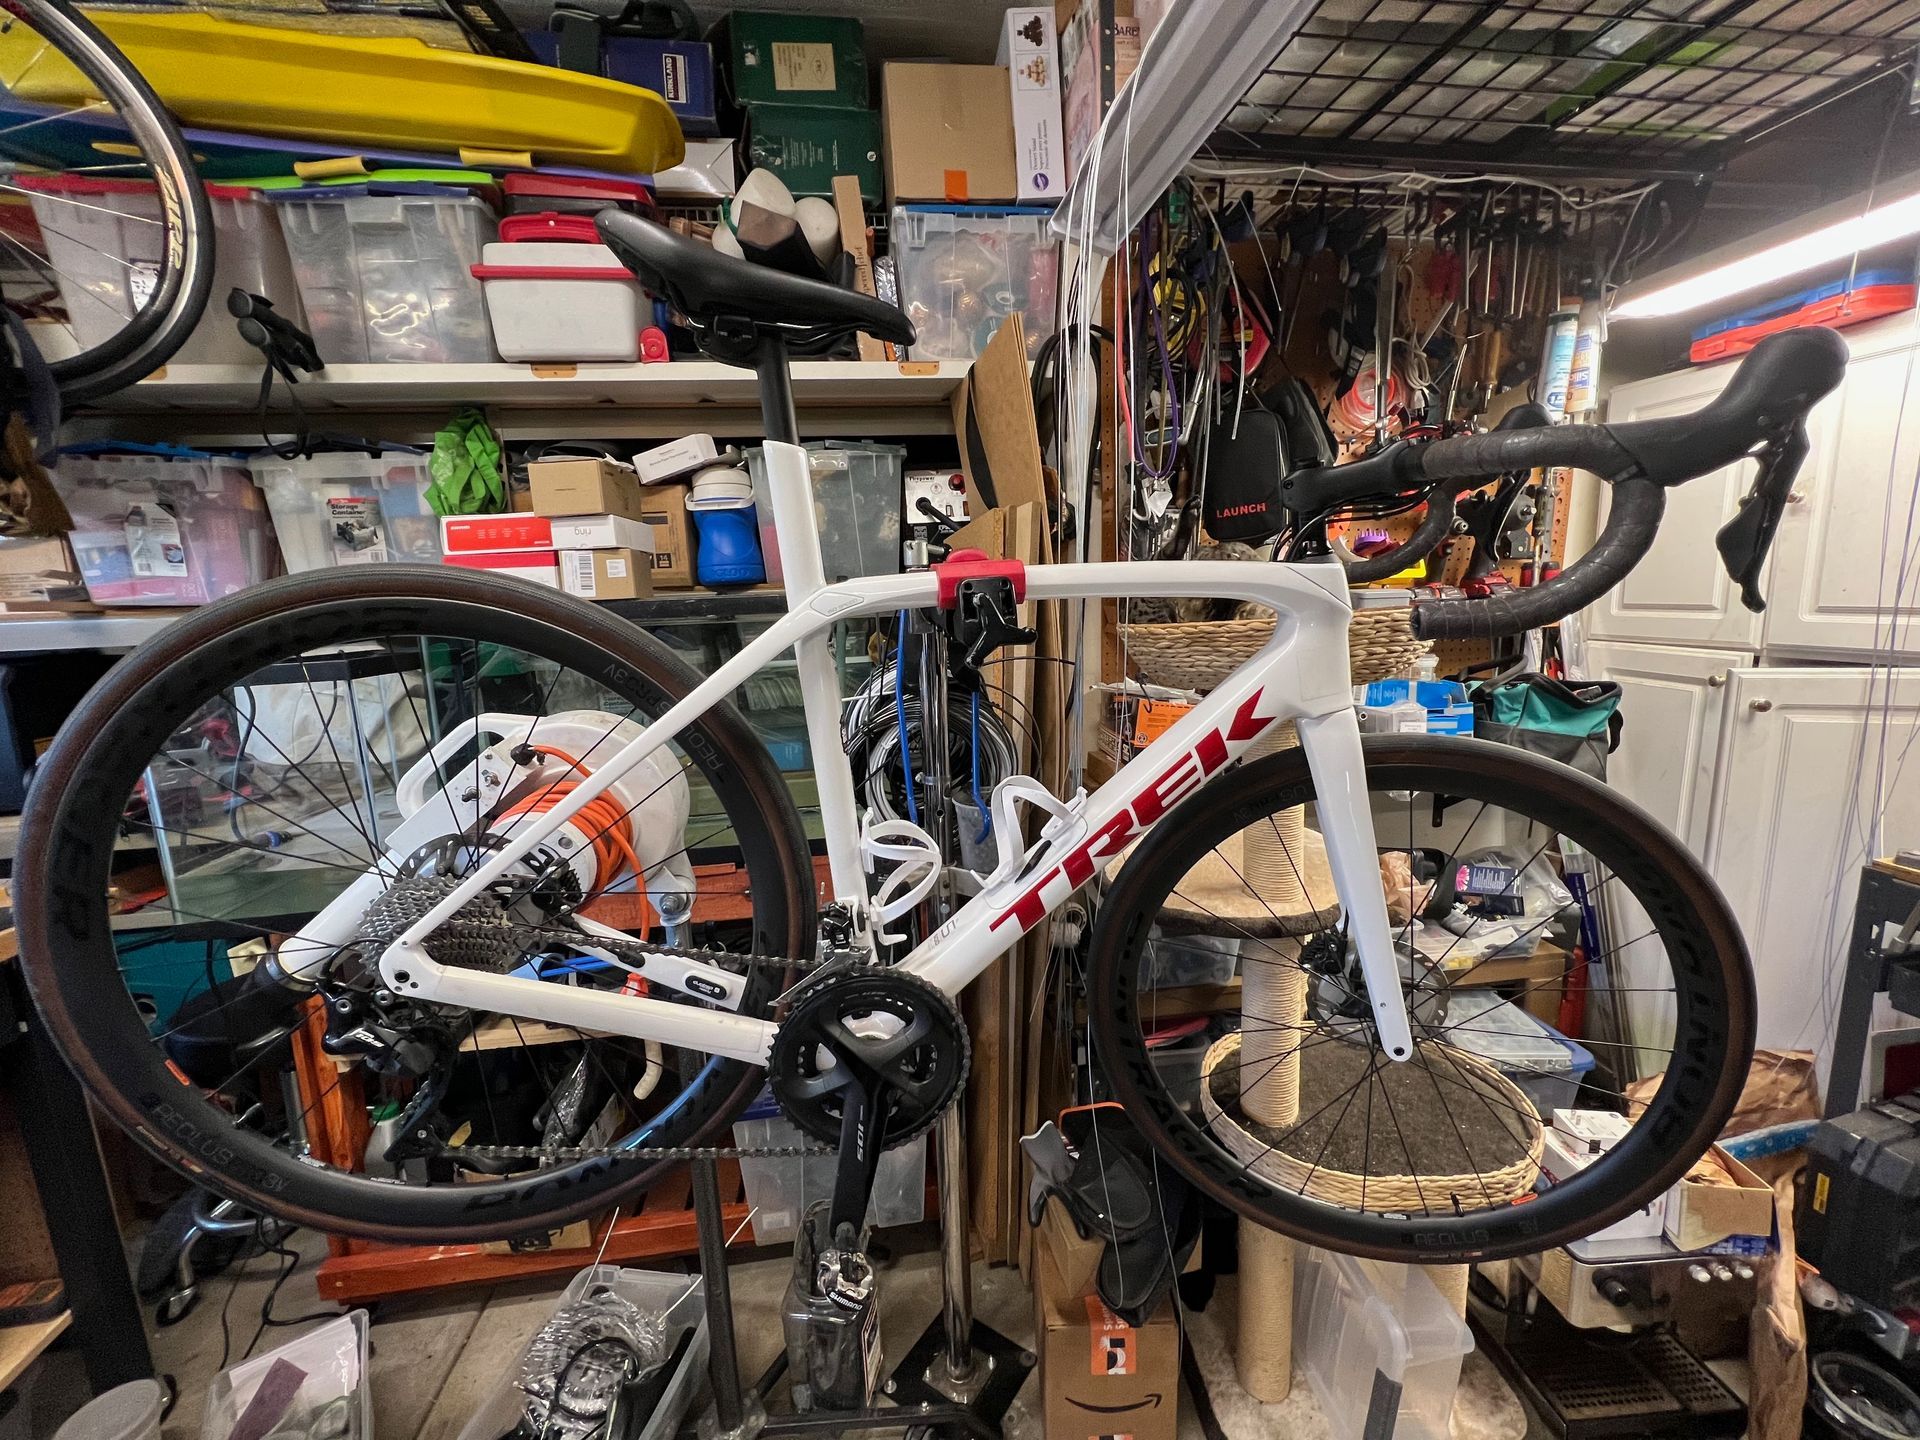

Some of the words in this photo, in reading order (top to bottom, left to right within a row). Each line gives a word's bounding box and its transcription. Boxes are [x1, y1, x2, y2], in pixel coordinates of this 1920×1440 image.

[664, 56, 674, 99] KIRKLAND
[330, 503, 359, 512] Storage
[1216, 502, 1266, 518] LAUNCH
[574, 526, 592, 536] ring
[989, 685, 1277, 933] TREK
[1414, 1229, 1490, 1247] AEOLUS
[829, 1291, 863, 1311] SHIMANO
